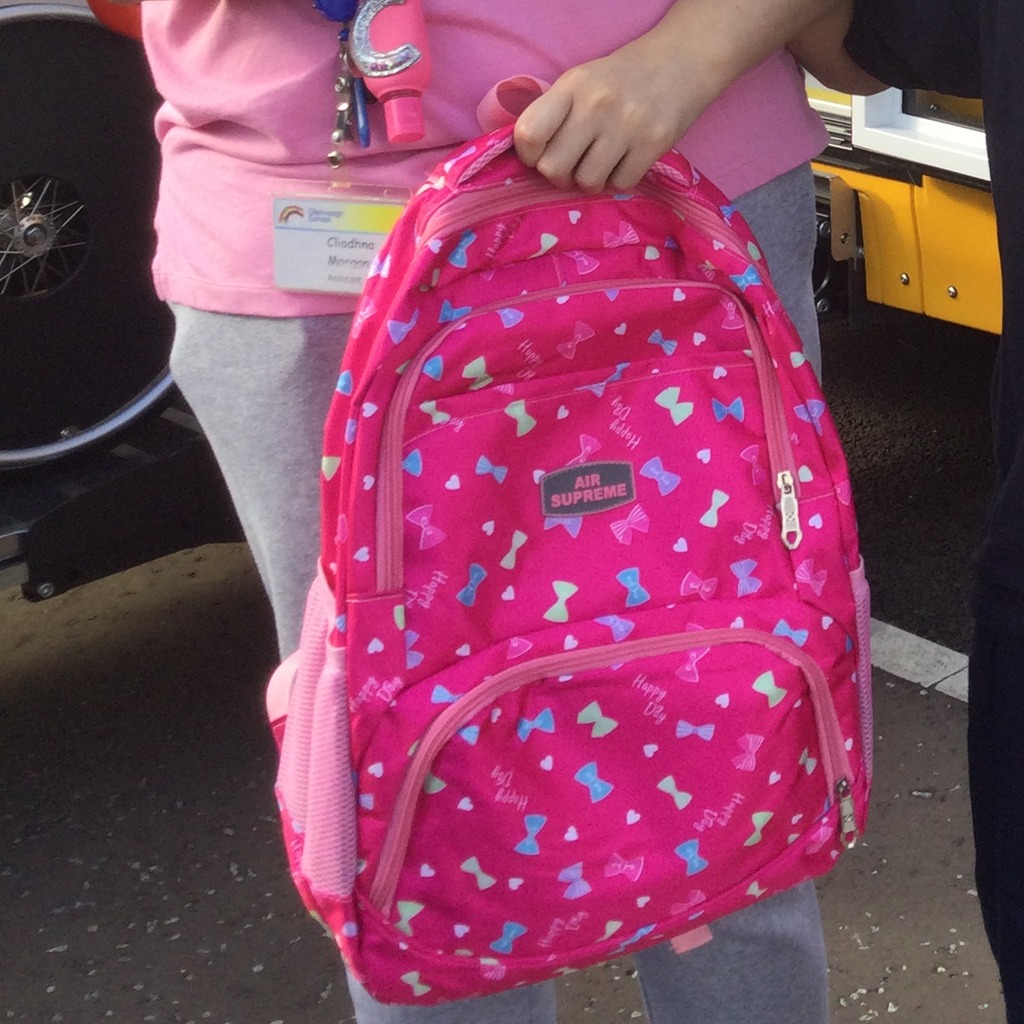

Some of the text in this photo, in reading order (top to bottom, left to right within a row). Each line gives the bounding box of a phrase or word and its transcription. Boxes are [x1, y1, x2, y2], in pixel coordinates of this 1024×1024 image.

[327, 237, 375, 250] Cliodhna
[609, 418, 641, 450] Happy
[574, 473, 601, 489] AIR
[550, 483, 627, 507] SUPREME
[631, 673, 667, 703] Happy
